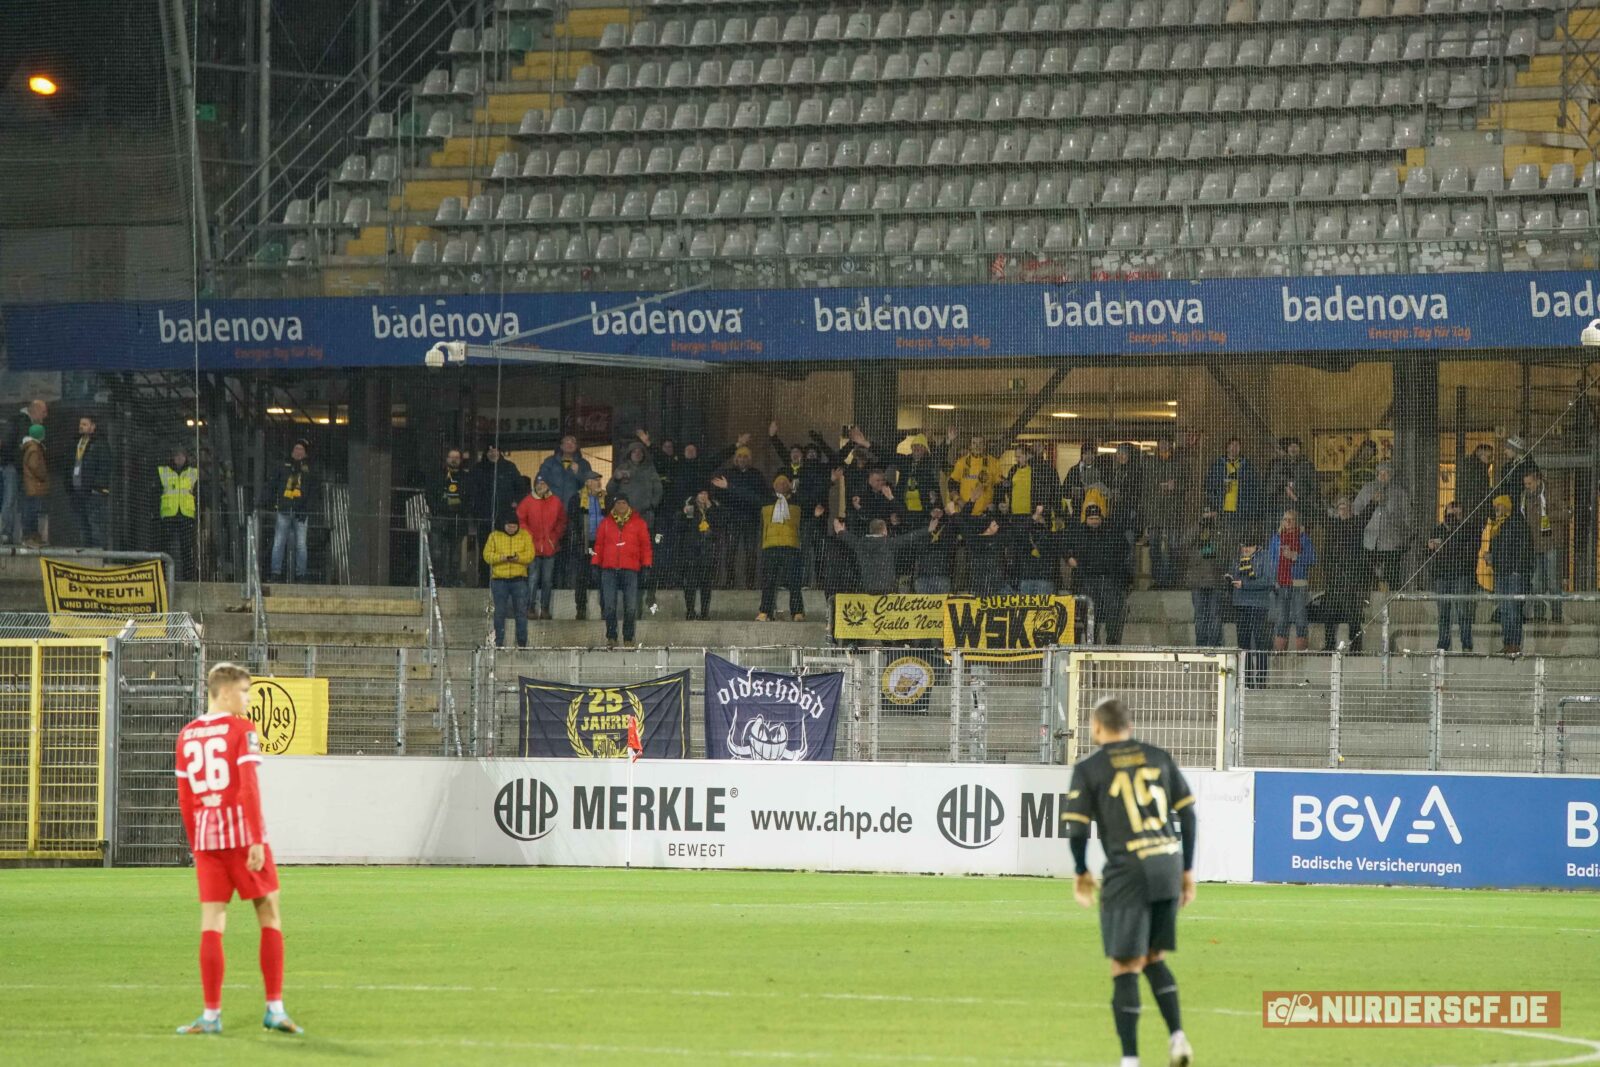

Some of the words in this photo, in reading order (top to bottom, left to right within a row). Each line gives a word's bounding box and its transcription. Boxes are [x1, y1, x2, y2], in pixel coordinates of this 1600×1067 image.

[814, 297, 969, 332] badenova
[1044, 290, 1204, 327] badenova
[1282, 285, 1448, 322] badenova
[1530, 280, 1600, 317] bad
[158, 309, 303, 343] badenova
[372, 304, 520, 339] badenova
[591, 301, 743, 335] badenova
[874, 595, 943, 615] Collettivo
[873, 615, 910, 635] Giallo
[948, 602, 1031, 649] WSK
[588, 688, 623, 713] 25
[581, 714, 630, 731] JAHRE
[183, 737, 230, 794] 26
[493, 778, 559, 841] AHP
[936, 784, 1005, 849] AHP
[1108, 767, 1168, 833] 15
[751, 805, 913, 840] www.ahp.de
[668, 843, 726, 858] BEWEGT
[1291, 855, 1352, 871] Badische
[1356, 857, 1462, 877] Versicherungen
[1567, 863, 1600, 877] Badi
